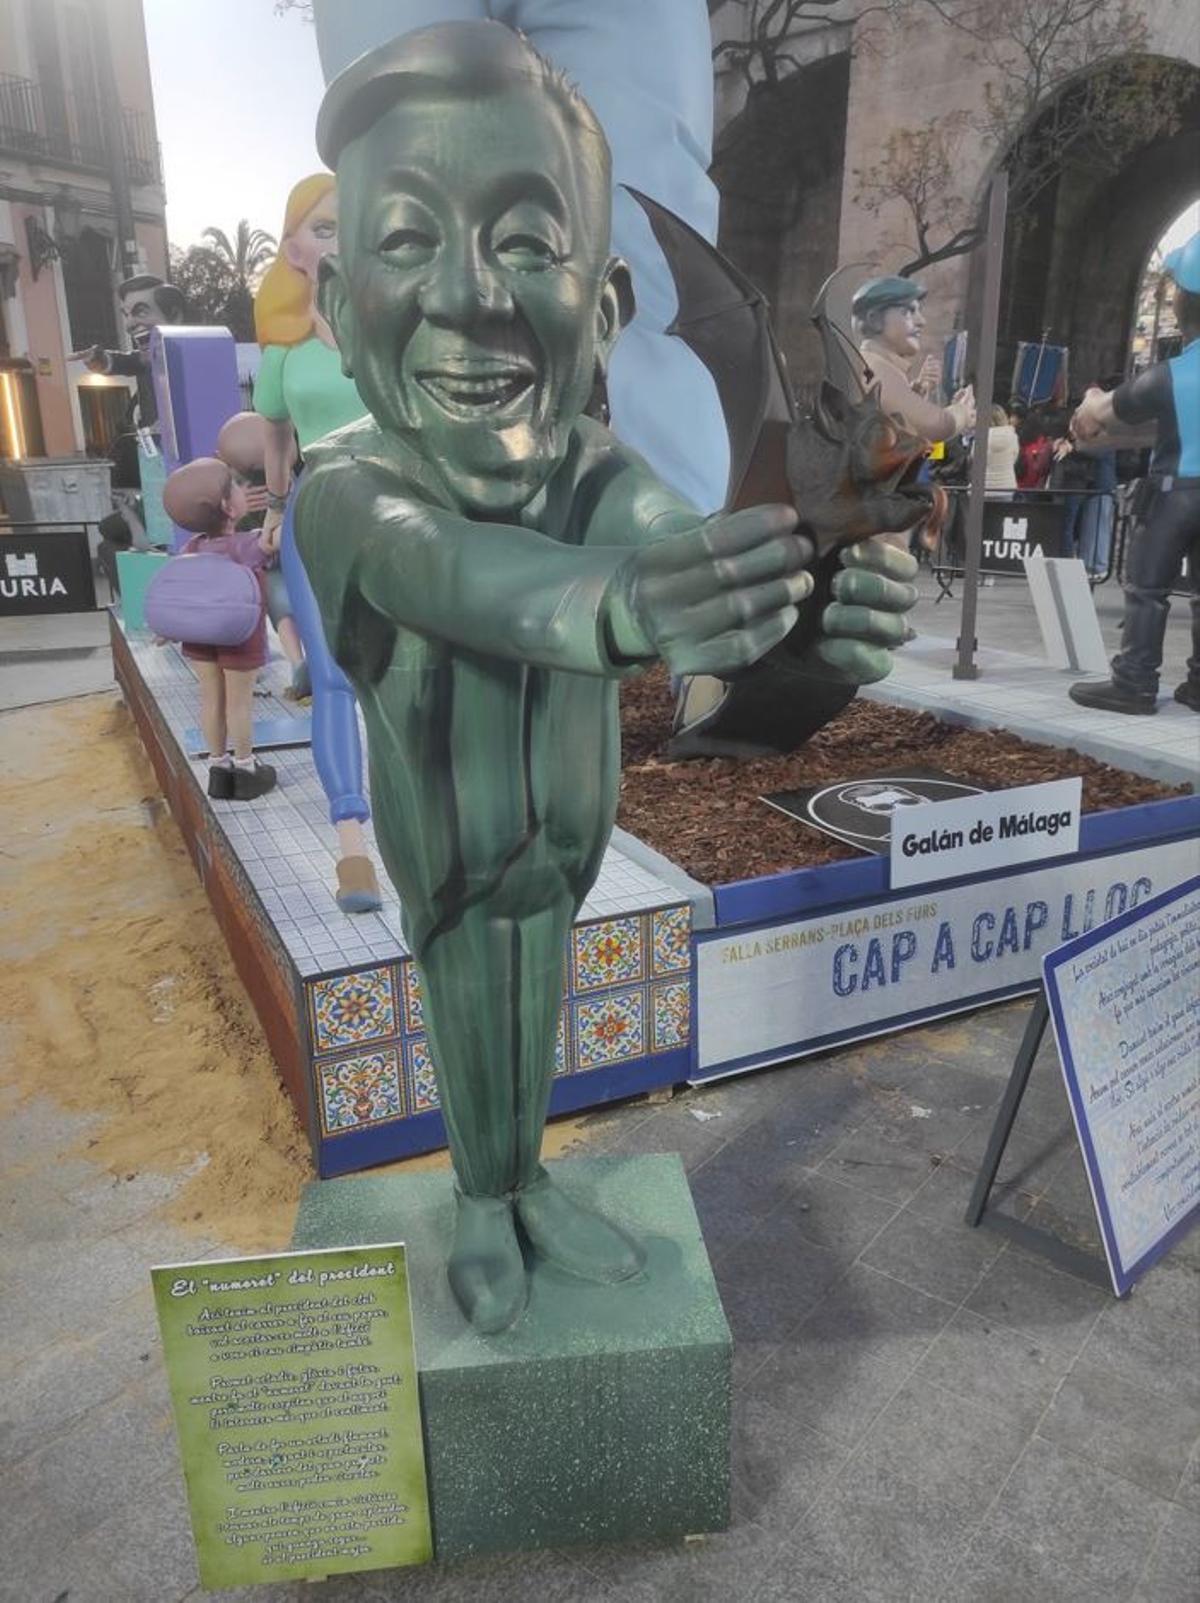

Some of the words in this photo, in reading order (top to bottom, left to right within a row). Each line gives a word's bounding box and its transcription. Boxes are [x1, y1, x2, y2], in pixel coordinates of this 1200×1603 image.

[982, 540, 1045, 559] TURIA
[902, 827, 963, 857] Galán
[969, 820, 994, 845] de
[999, 810, 1072, 839] Málaga
[873, 909, 904, 934] DELS
[906, 902, 939, 924] FURS
[832, 930, 917, 998] CAP
[930, 920, 956, 974] A
[970, 901, 1049, 963] CAP
[170, 1279, 197, 1297] El
[288, 1269, 315, 1285] del
